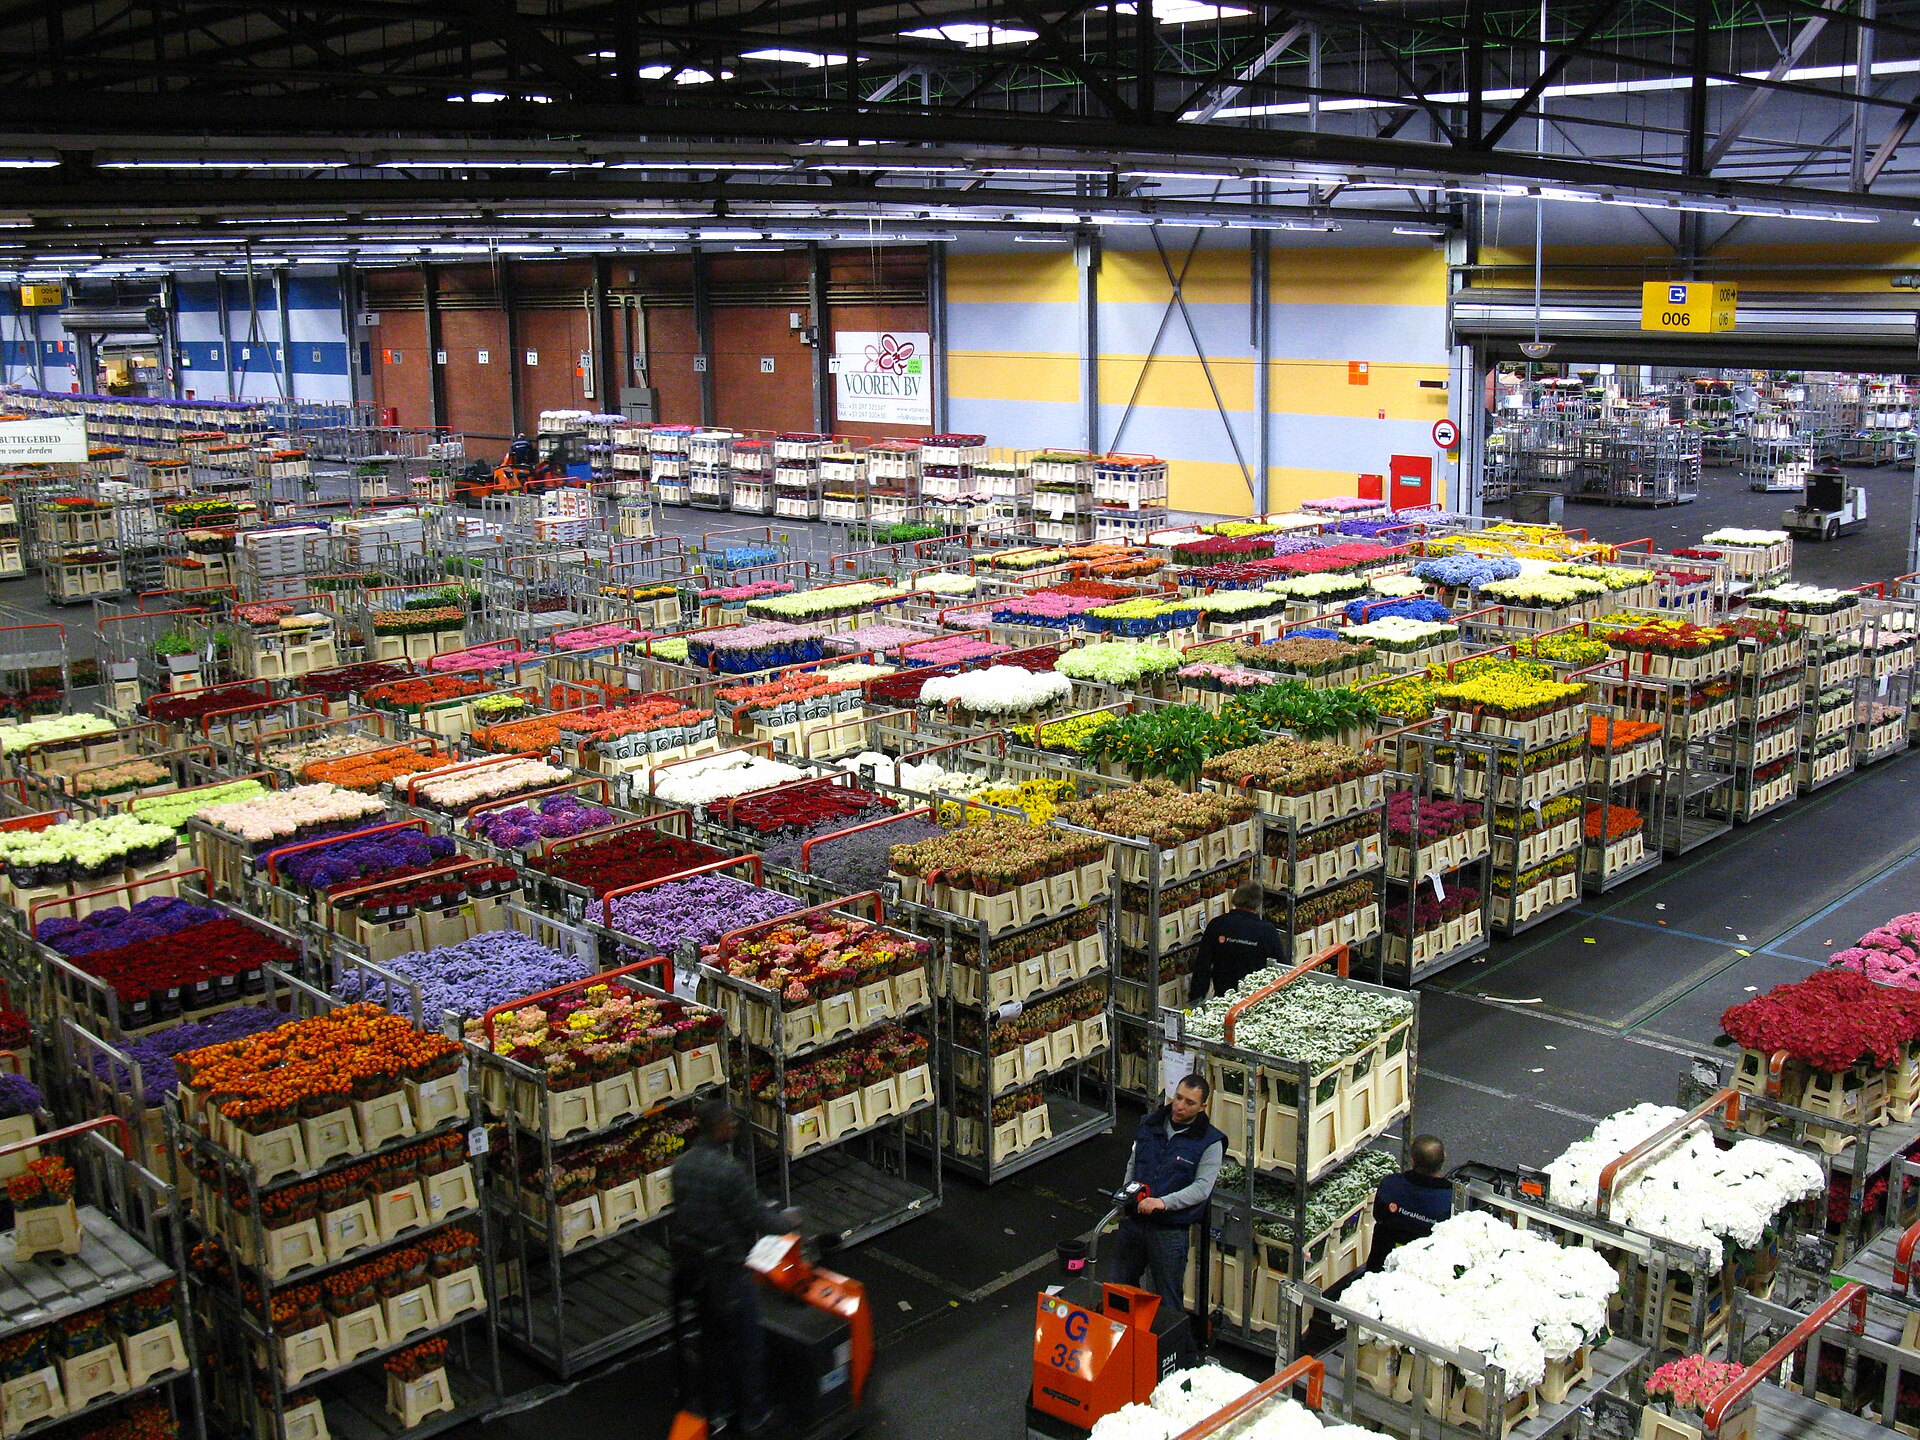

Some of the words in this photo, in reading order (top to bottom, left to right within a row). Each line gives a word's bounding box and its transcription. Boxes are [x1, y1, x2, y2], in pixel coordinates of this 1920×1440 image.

[1719, 288, 1731, 302] 006
[365, 315, 372, 324] F
[1662, 312, 1690, 326] 006
[438, 354, 446, 363] 71
[480, 353, 487, 362] 72
[529, 354, 536, 364] 72
[582, 356, 590, 366] 73
[635, 359, 644, 368] 74
[696, 360, 704, 369] 75
[763, 360, 772, 370] 76
[831, 361, 840, 371] 77
[844, 374, 900, 396] VOOREN
[903, 376, 921, 396] BV
[1065, 1310, 1090, 1344] G
[1050, 1343, 1083, 1373] 35
[1162, 1351, 1177, 1368] 2341
